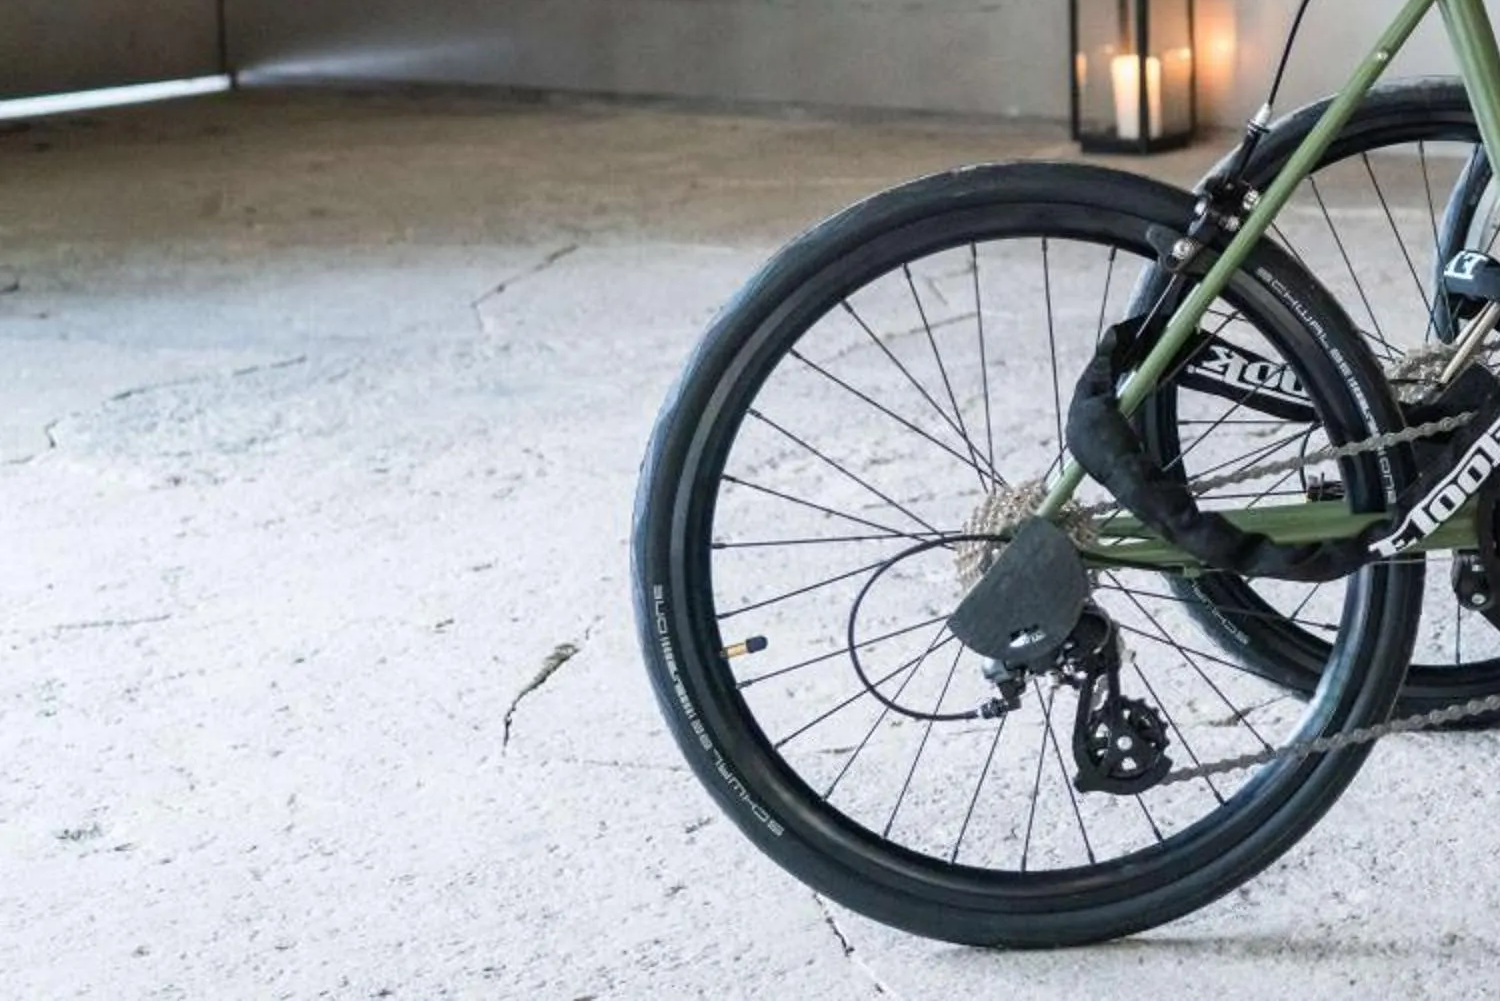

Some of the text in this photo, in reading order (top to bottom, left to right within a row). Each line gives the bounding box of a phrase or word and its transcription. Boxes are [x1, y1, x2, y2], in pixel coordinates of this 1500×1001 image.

[1256, 266, 1353, 378] SCHWALBE
[653, 584, 785, 837] SCHWALBE ONE
